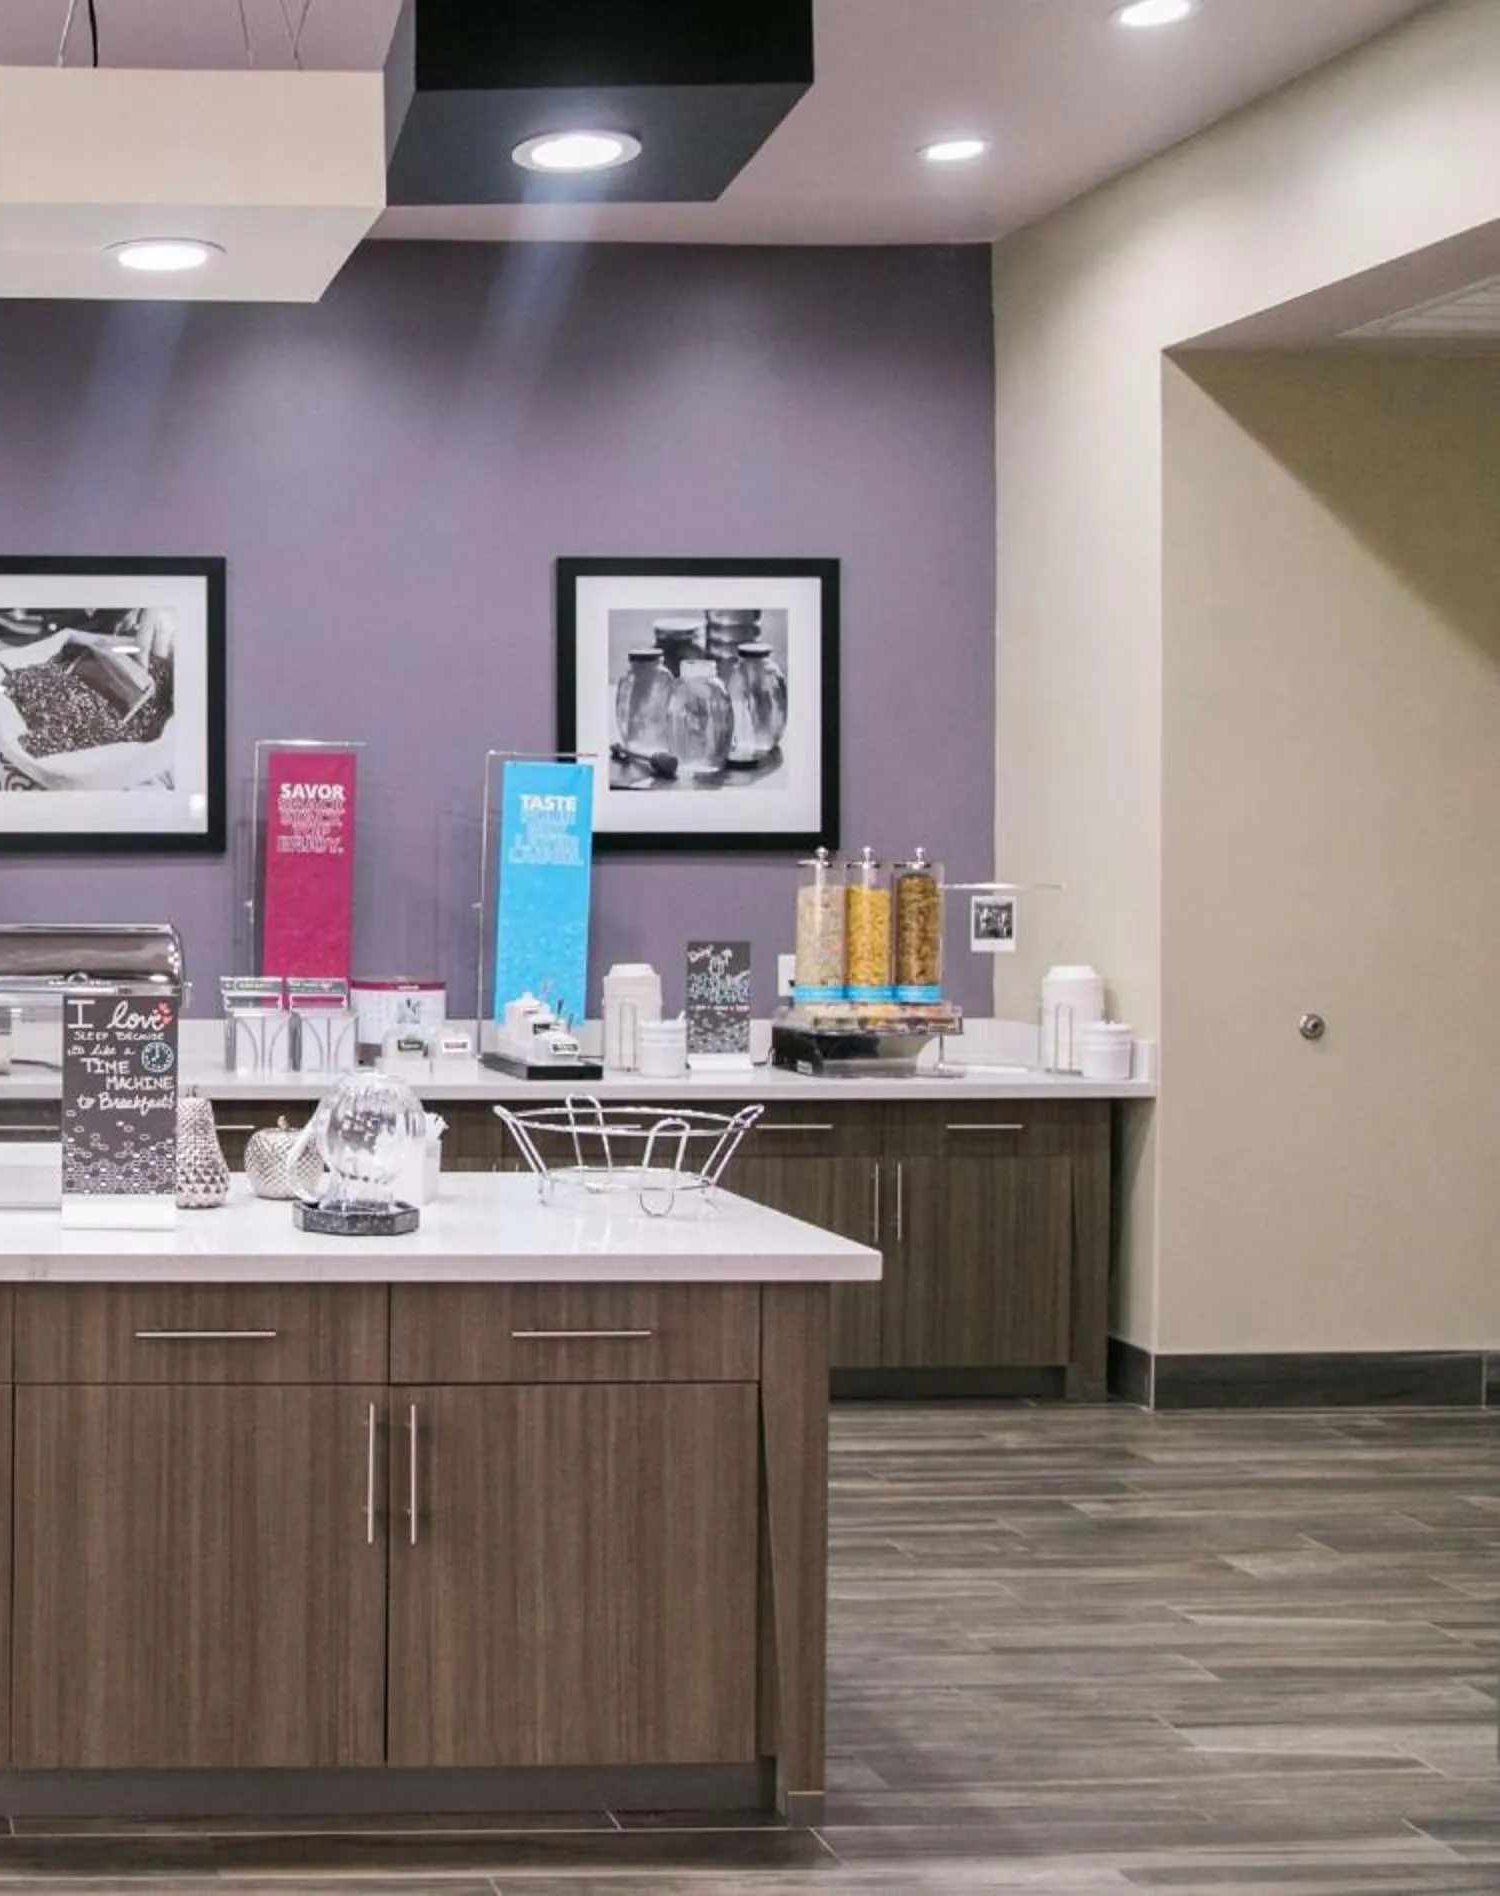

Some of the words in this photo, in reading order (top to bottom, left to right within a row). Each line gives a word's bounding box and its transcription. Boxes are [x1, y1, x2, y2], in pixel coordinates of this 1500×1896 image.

[280, 783, 346, 800] SAVOR
[520, 793, 577, 812] TASTE
[67, 1000, 95, 1029] I
[106, 1000, 165, 1031] love
[80, 1057, 130, 1075] TIME
[105, 1075, 175, 1090] MACHINE
[76, 1094, 97, 1109] to
